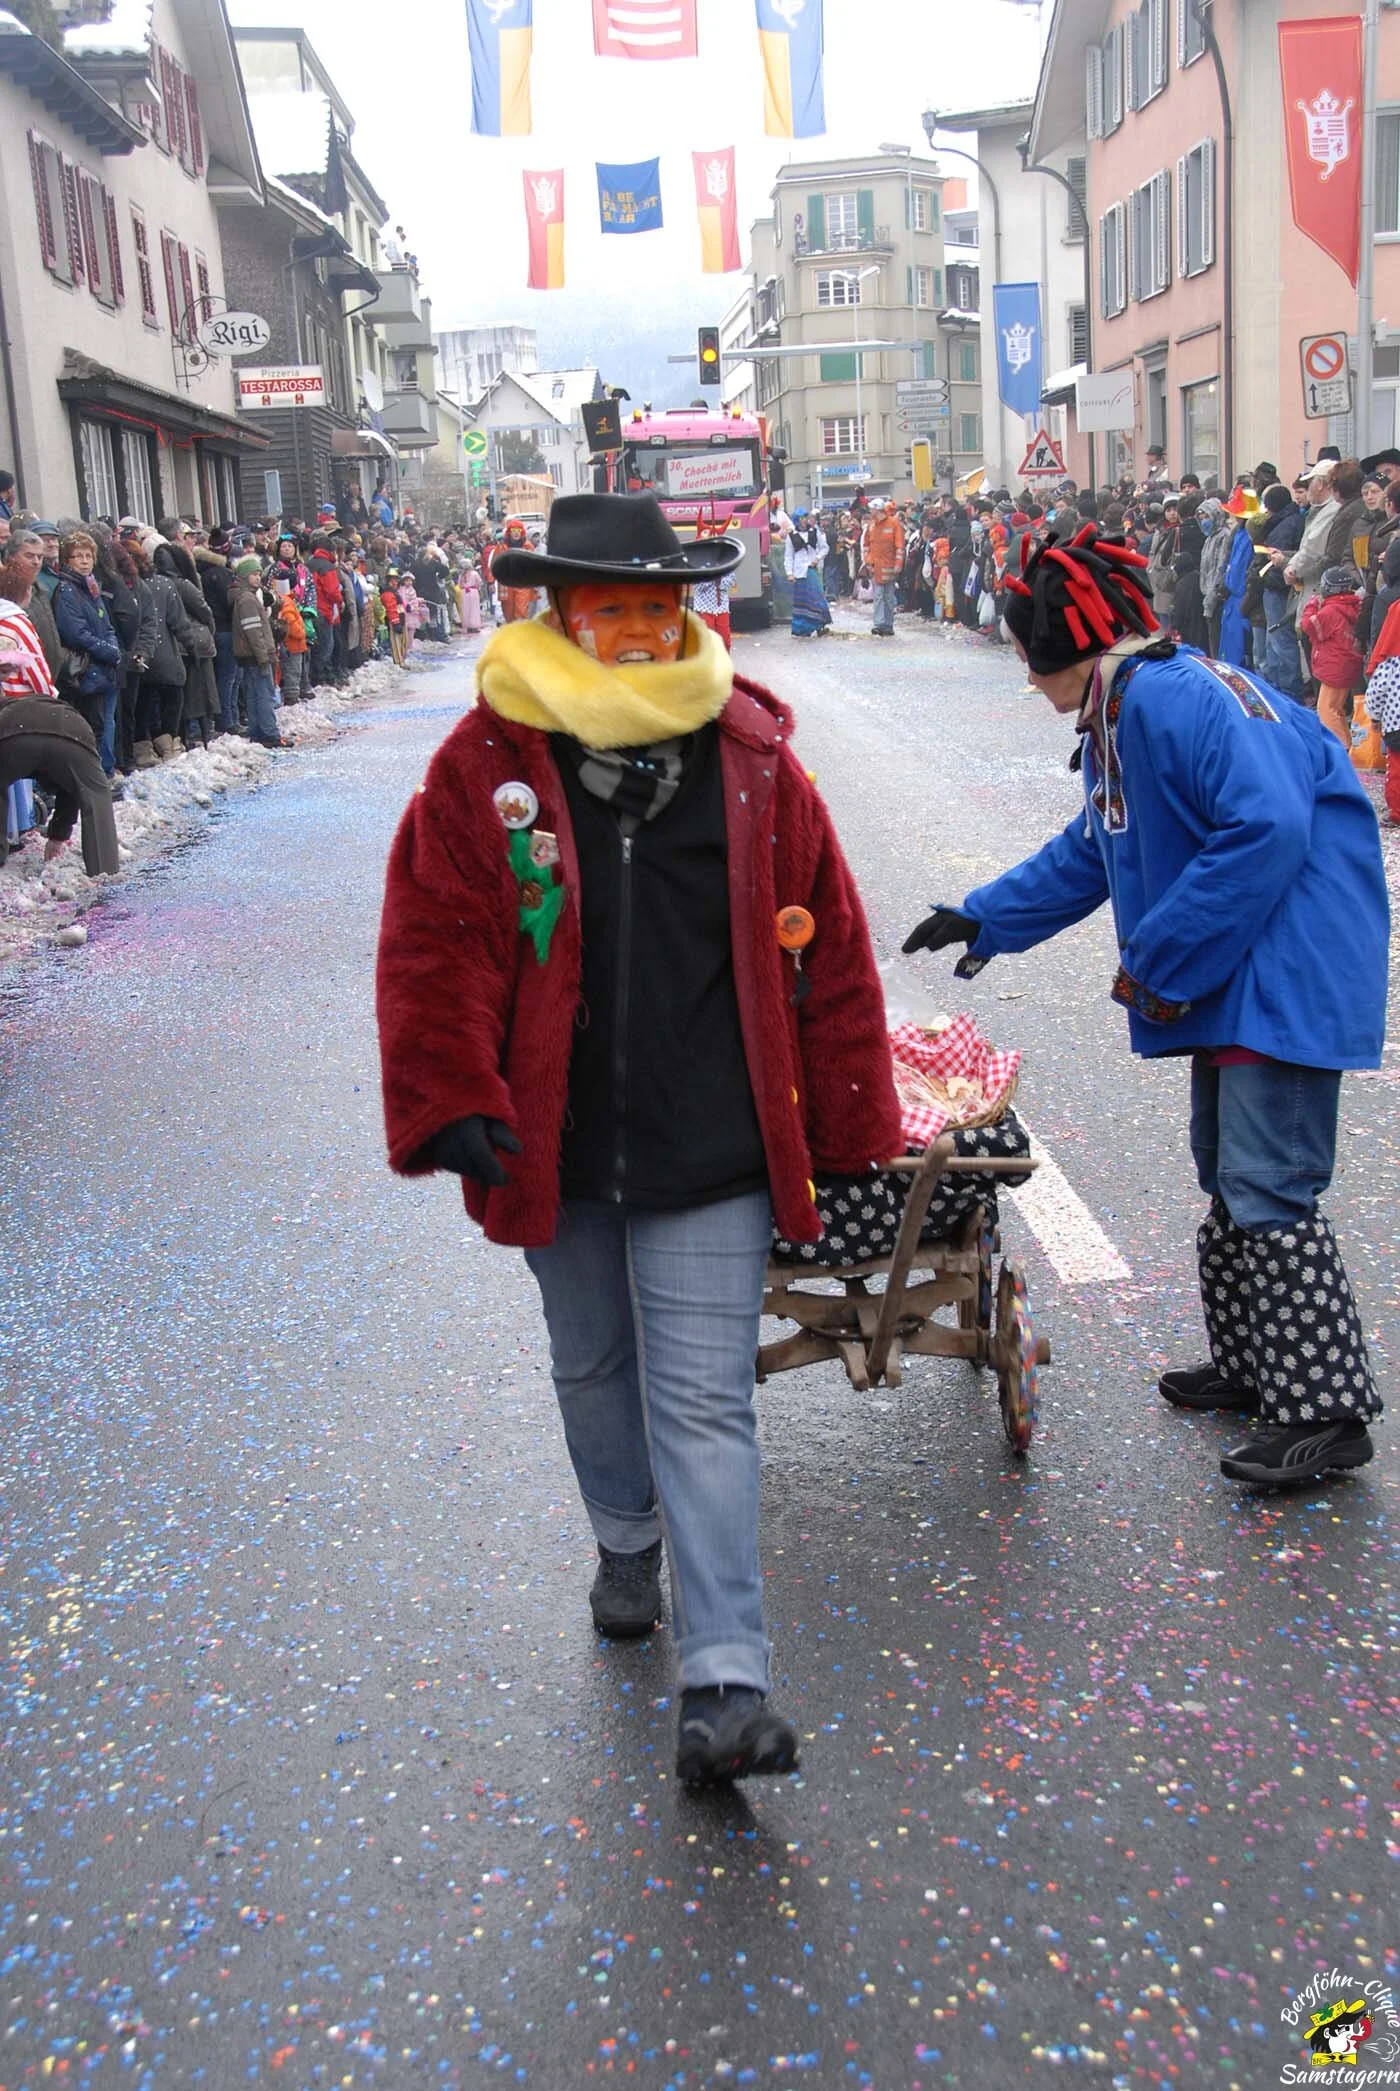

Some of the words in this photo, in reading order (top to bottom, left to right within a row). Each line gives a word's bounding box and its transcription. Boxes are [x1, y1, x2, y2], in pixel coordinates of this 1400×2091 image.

[207, 319, 269, 347] Rigi
[261, 369, 300, 377] Pizzeria
[242, 380, 321, 393] TESTAROSSA
[720, 459, 737, 469] mit
